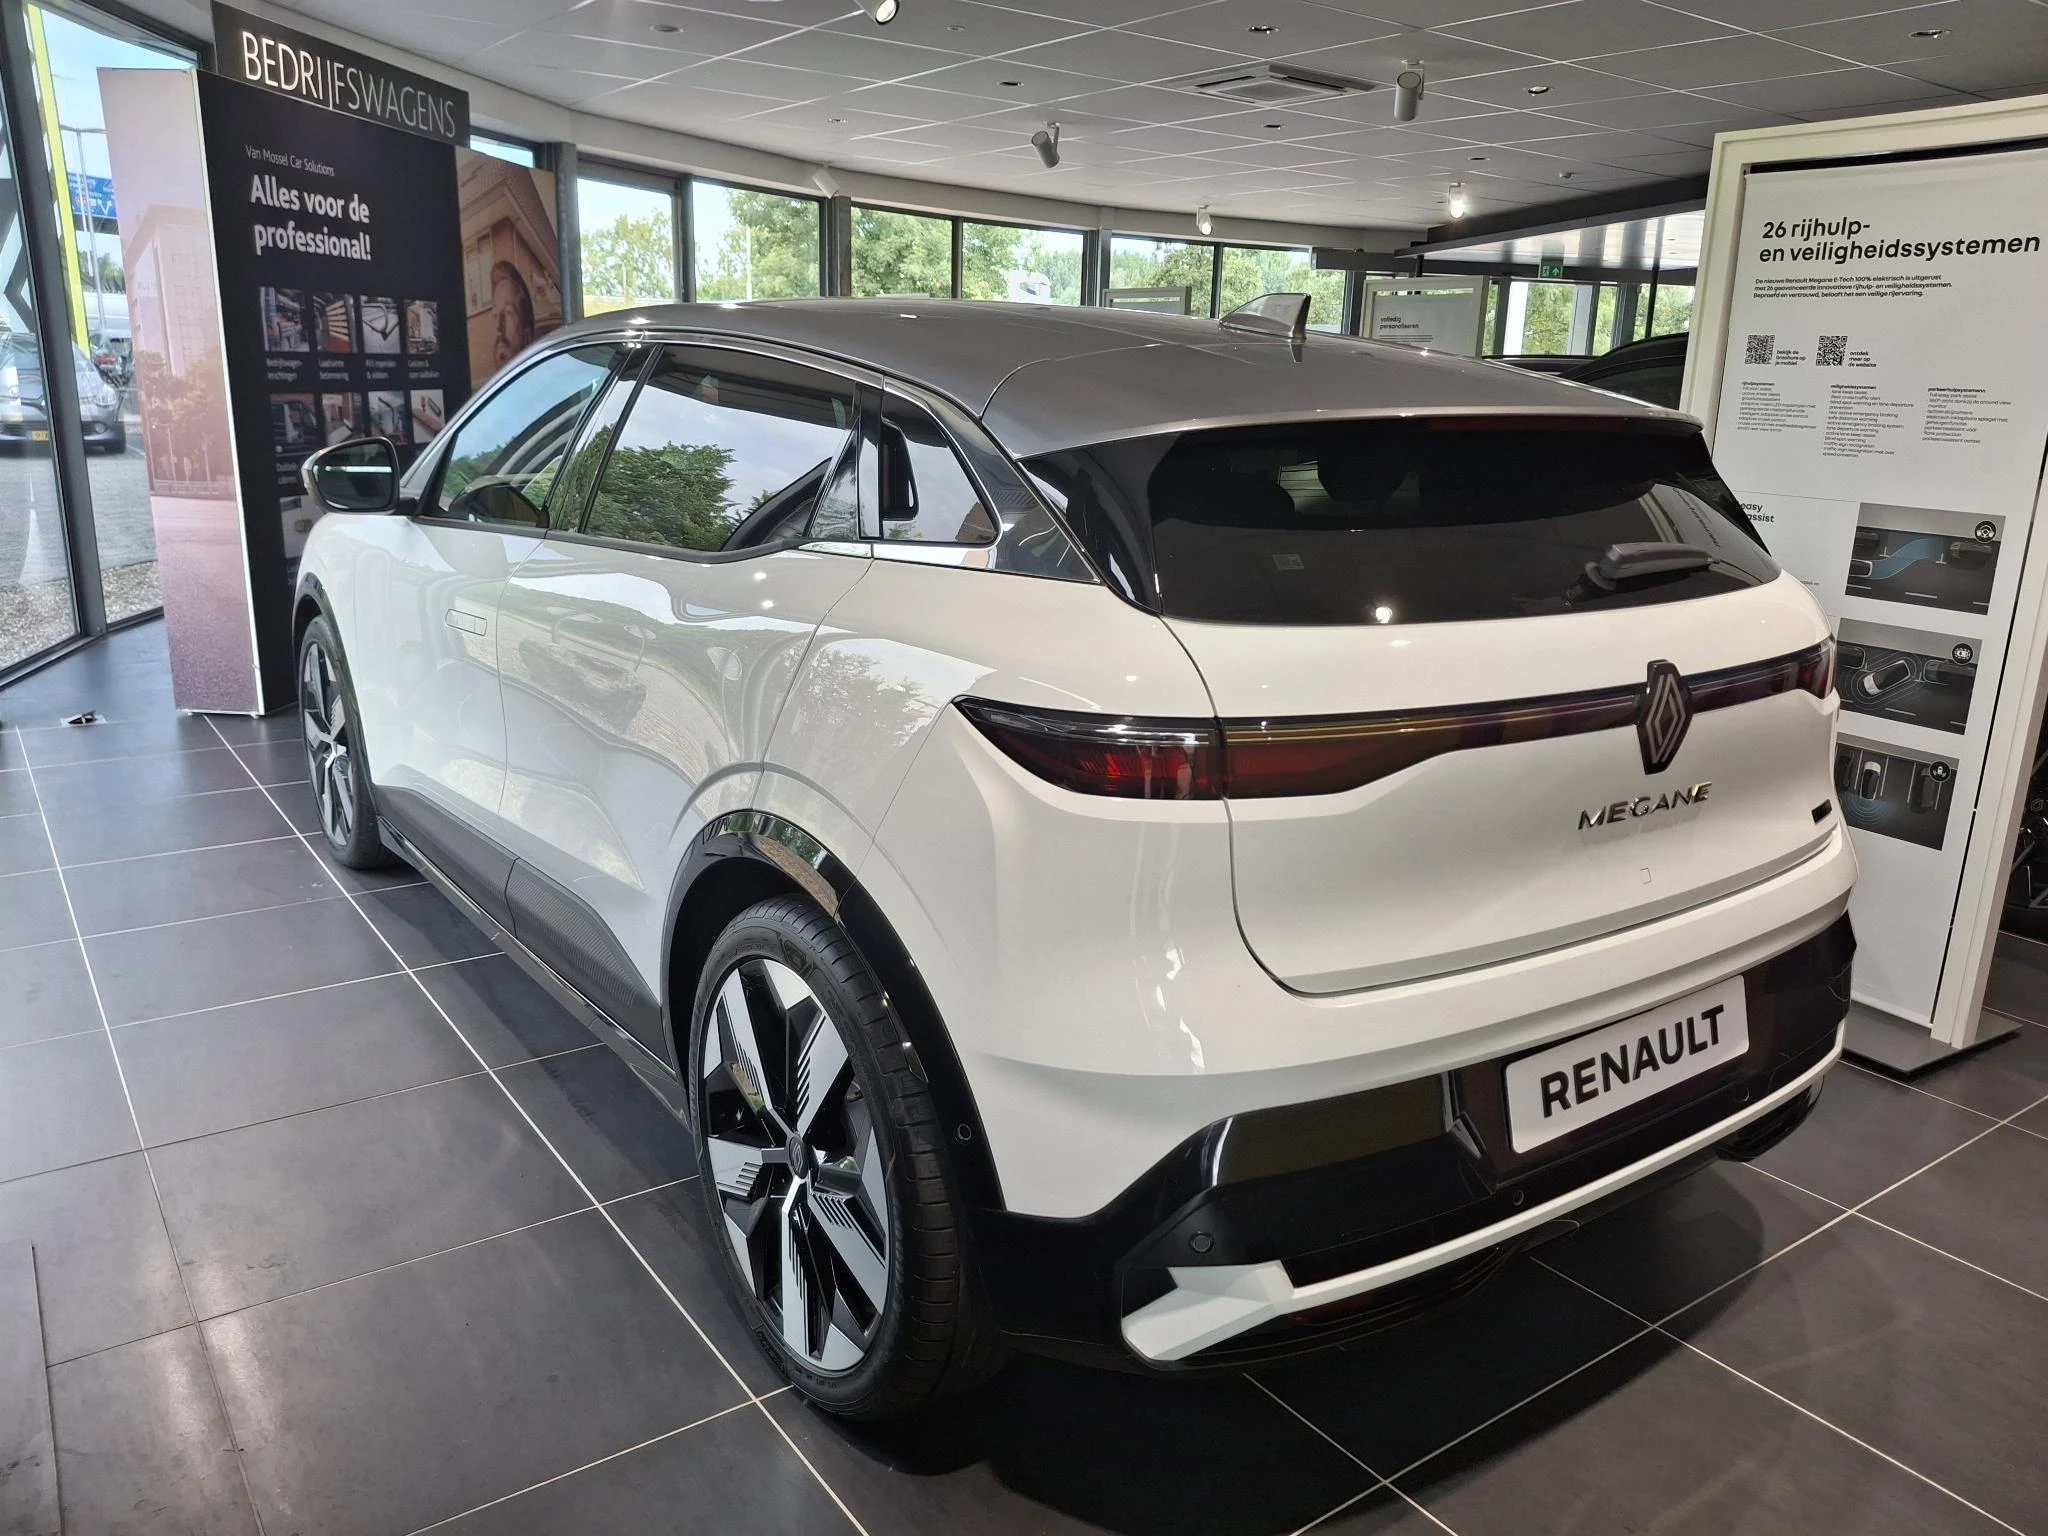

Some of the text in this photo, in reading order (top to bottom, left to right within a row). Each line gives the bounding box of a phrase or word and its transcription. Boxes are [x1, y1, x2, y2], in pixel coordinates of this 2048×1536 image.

[242, 30, 456, 138] BEDRIJFSWAGENS
[245, 144, 335, 176] Van Mossel Car Solutions
[250, 174, 370, 223] Alles voor de
[254, 220, 371, 260] professional!
[1763, 217, 1870, 241] 26 rijhulp-
[1759, 235, 2040, 264] en veiligheidssystemen
[1740, 503, 1763, 512] easy
[1578, 781, 1712, 830] MEGANE
[1540, 1004, 1724, 1118] RENAULT
